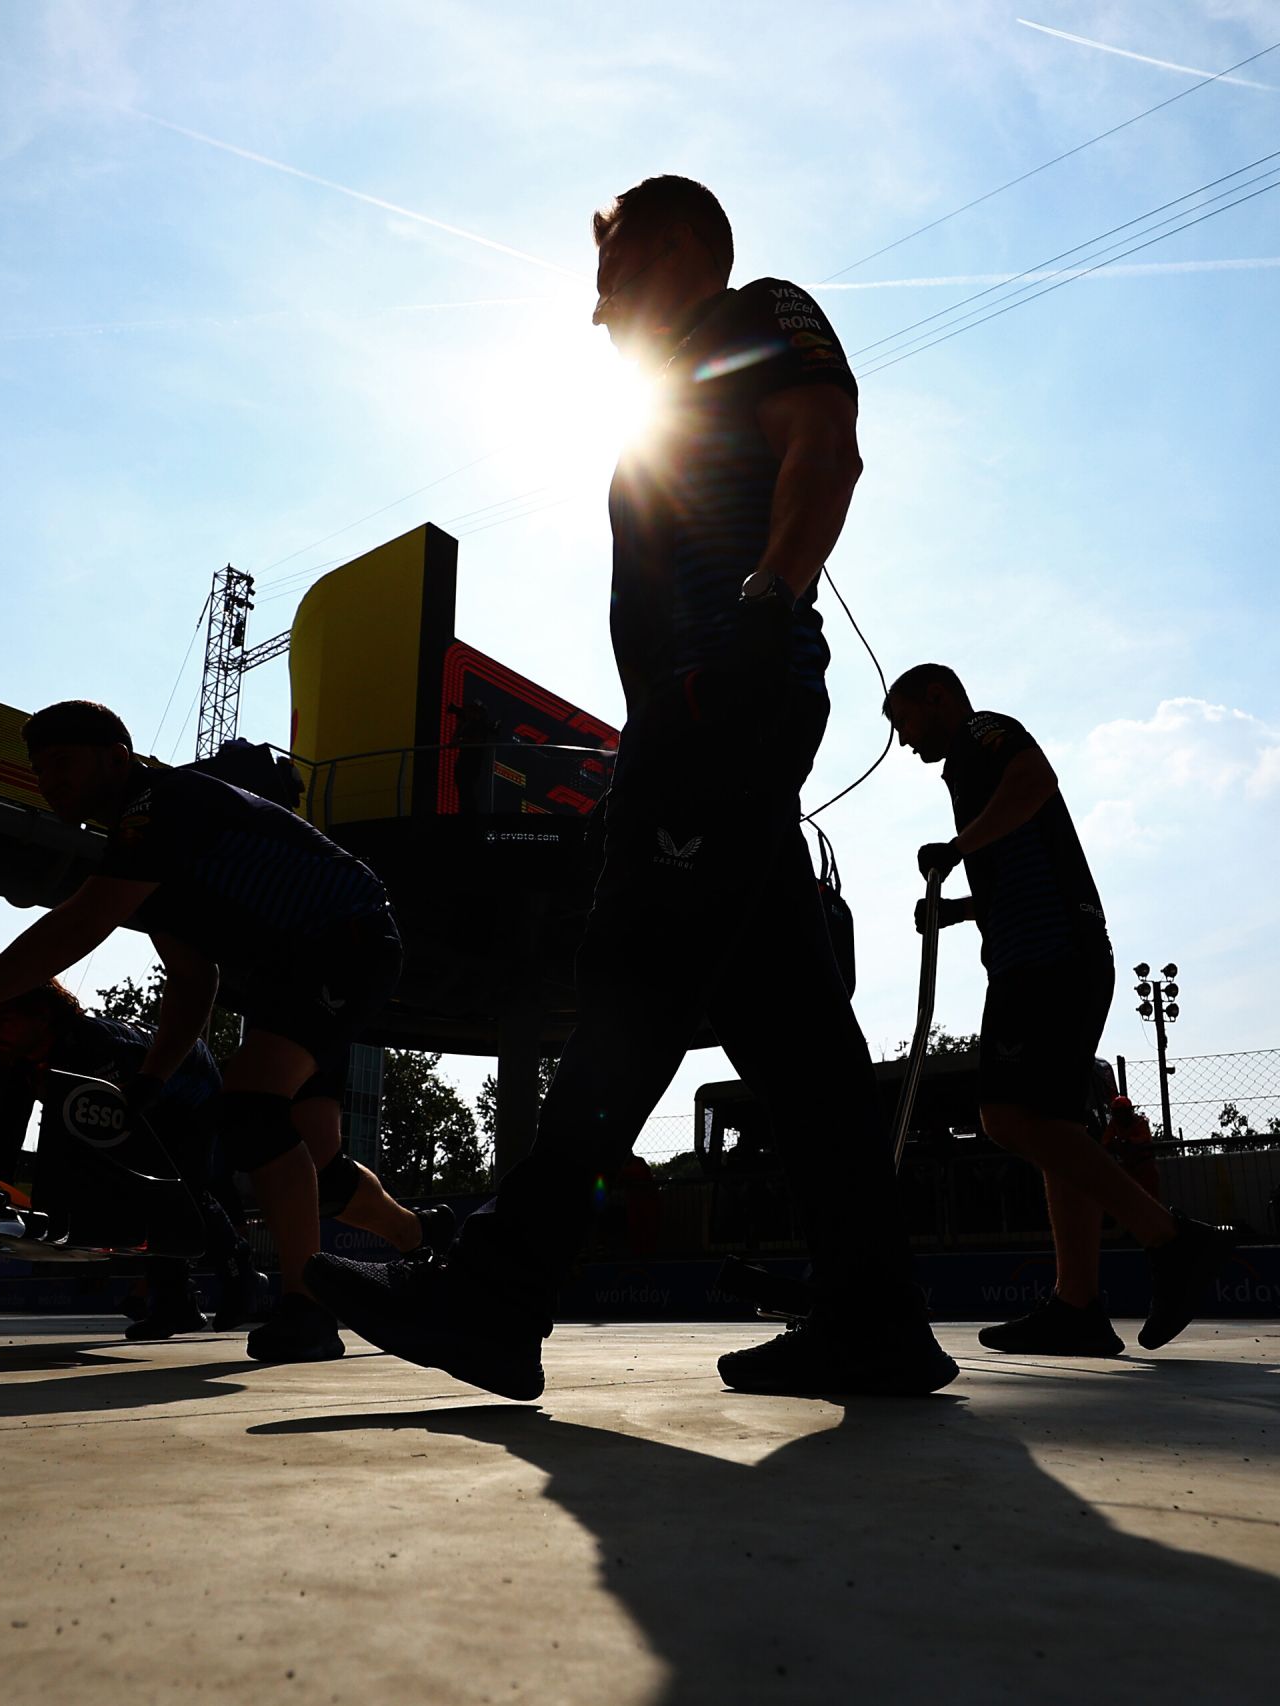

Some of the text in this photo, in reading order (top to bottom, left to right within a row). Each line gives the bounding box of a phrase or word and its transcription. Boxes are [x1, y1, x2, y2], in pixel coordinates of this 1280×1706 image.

[500, 831, 560, 843] crypto.com
[75, 1096, 125, 1130] Esso
[594, 1284, 671, 1309] workday
